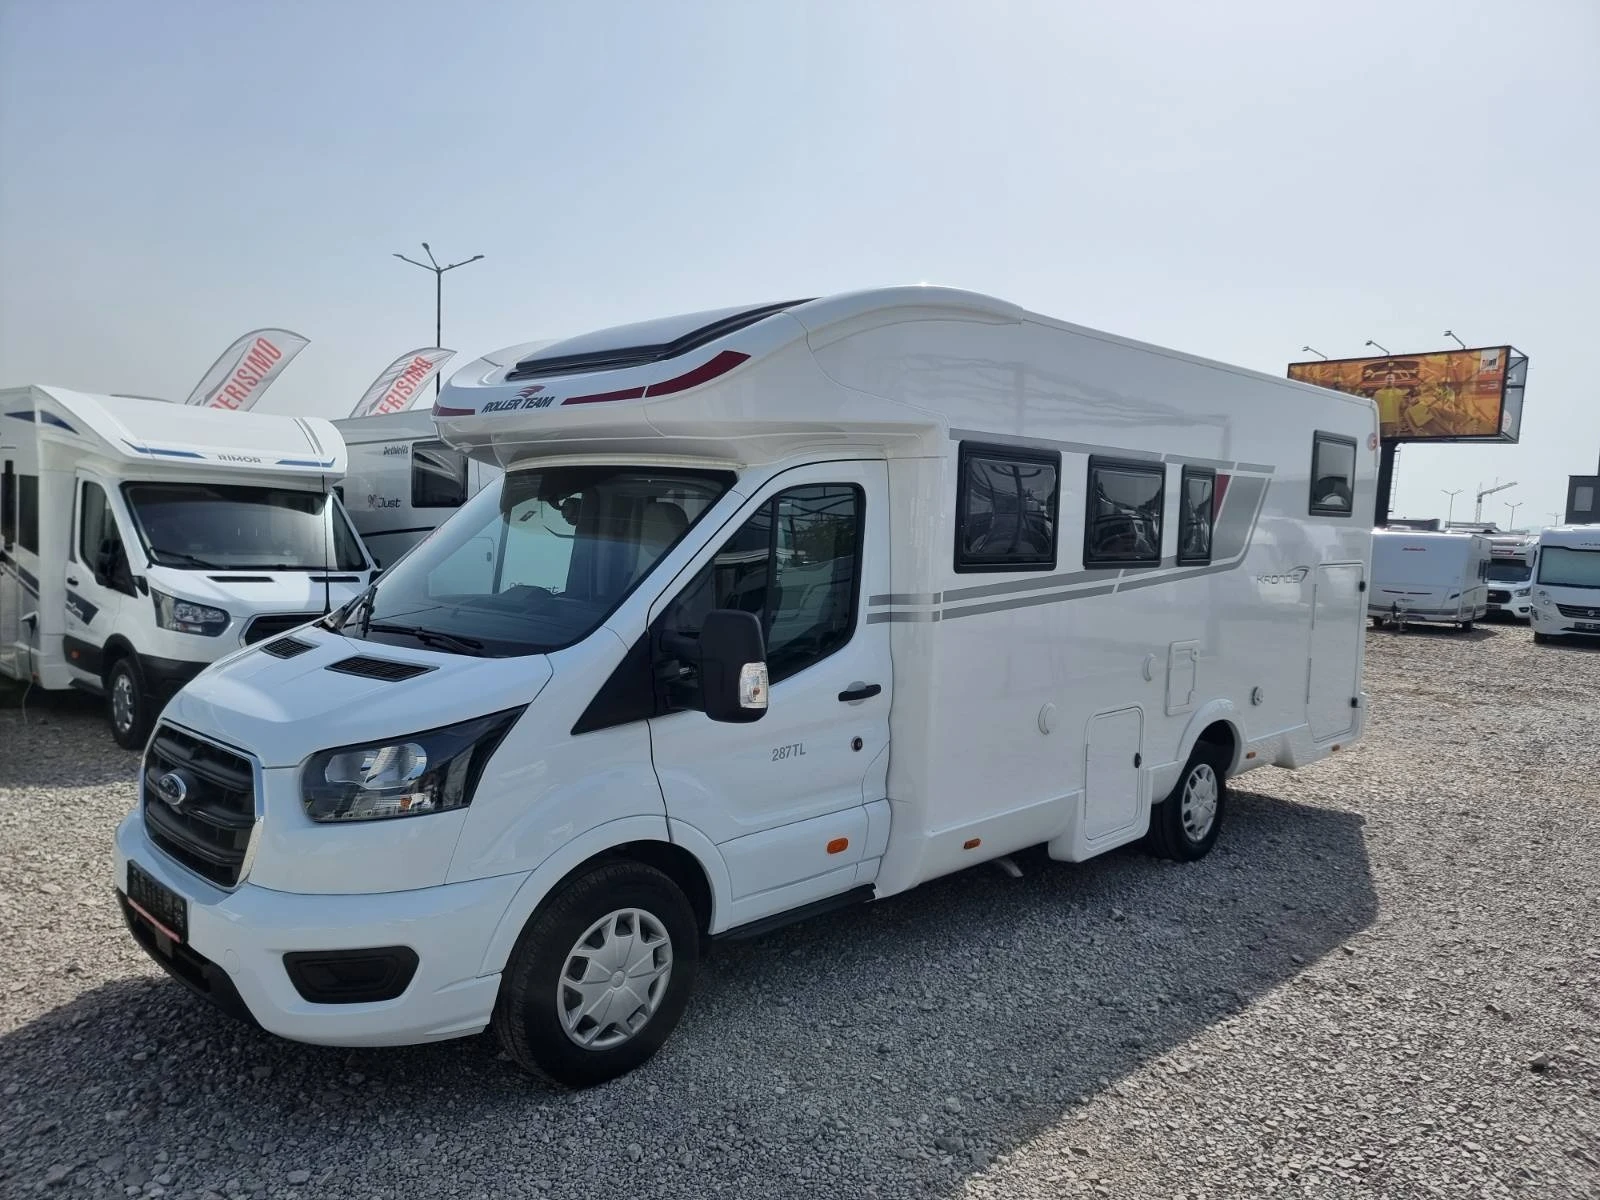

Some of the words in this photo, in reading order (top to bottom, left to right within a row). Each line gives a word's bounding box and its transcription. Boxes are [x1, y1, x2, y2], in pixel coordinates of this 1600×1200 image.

[373, 356, 433, 416] ERISIMO
[481, 399, 523, 413] ROLLER
[521, 396, 556, 409] TEAM
[217, 454, 262, 464] RIMOR
[378, 497, 401, 508] Just
[771, 742, 807, 762] 287TL
